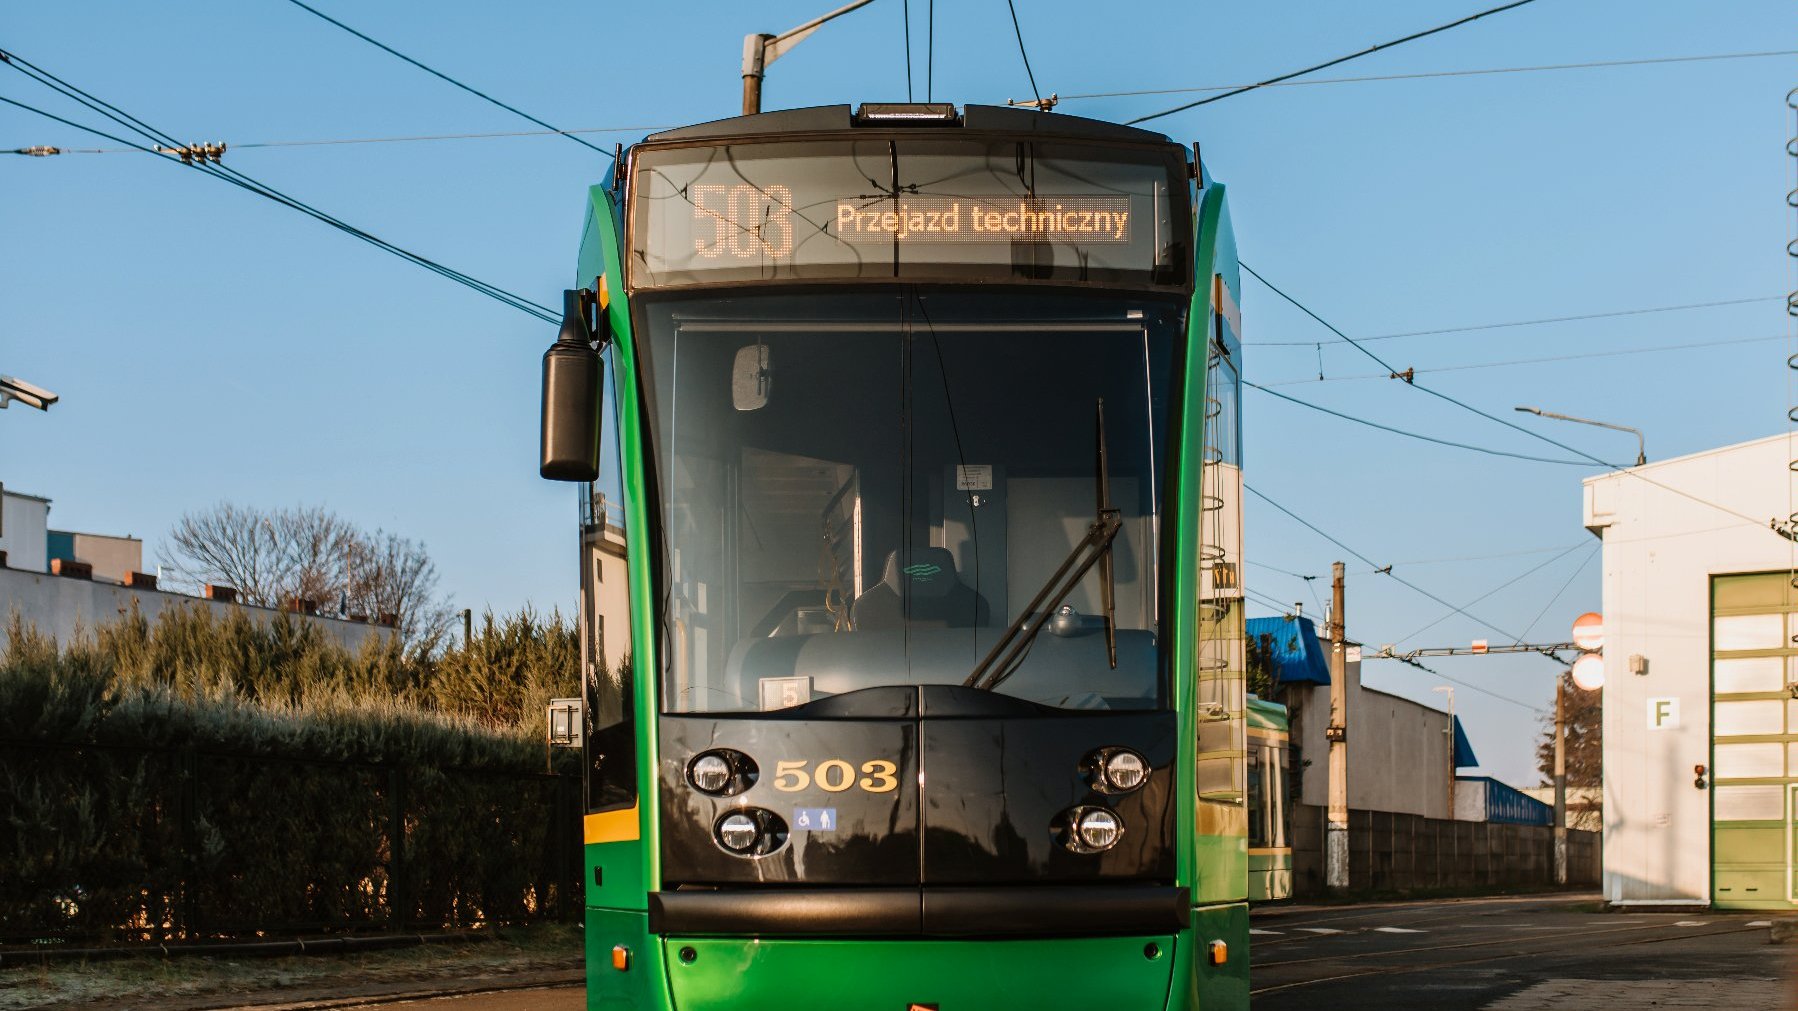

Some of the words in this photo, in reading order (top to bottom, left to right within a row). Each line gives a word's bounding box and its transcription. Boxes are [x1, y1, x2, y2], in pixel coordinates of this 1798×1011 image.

[695, 184, 792, 258] 503
[837, 203, 959, 238] Przejazd
[971, 203, 1129, 238] techniczny
[1656, 701, 1671, 726] F
[774, 759, 898, 792] 503
